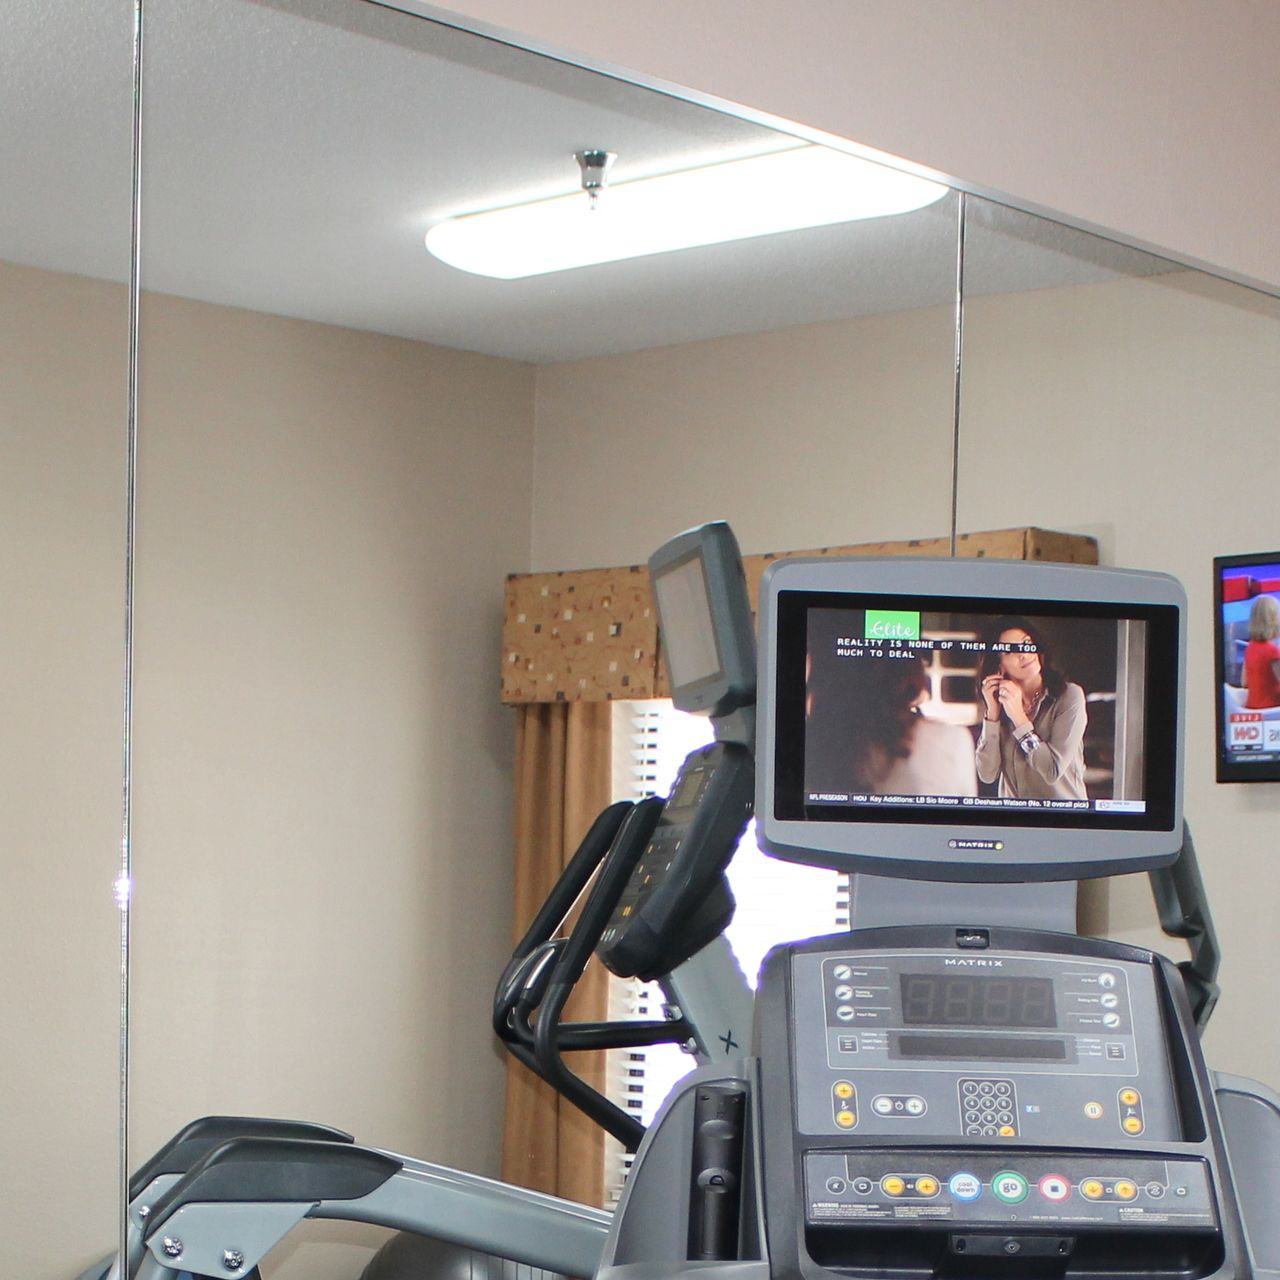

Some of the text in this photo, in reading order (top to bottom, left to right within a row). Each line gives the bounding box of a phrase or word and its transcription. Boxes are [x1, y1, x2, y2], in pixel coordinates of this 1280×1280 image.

[871, 620, 916, 638] Elite
[837, 638, 1038, 653] REALITY IS NONE OF THEM ARE TOO
[837, 649, 915, 659] MUCH TO DEAL
[870, 795, 882, 804] Key
[883, 795, 915, 803] Additions:
[938, 797, 959, 805] Moore
[974, 798, 1003, 806] Deshaun
[1003, 799, 1027, 807] Watson
[1028, 800, 1042, 808] (No.
[1043, 800, 1051, 808] 12
[1073, 801, 1090, 809] pick)
[958, 841, 993, 849] MATRIX
[944, 958, 1003, 967] MATRIX
[1003, 1182, 1018, 1194] go
